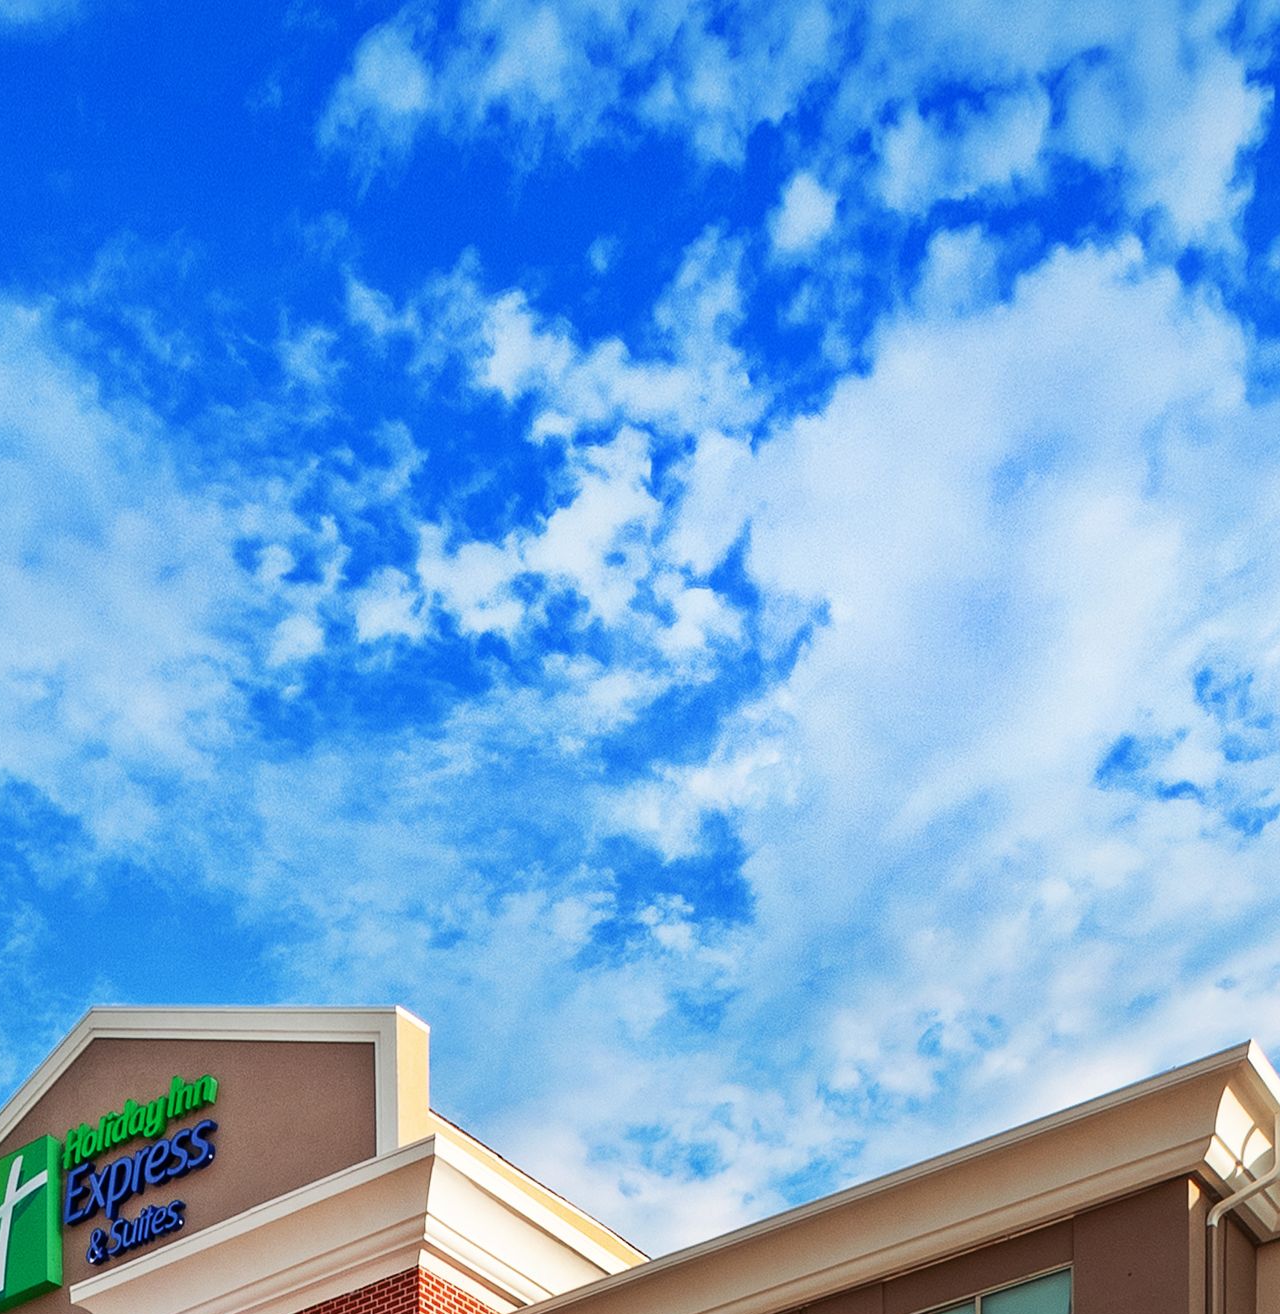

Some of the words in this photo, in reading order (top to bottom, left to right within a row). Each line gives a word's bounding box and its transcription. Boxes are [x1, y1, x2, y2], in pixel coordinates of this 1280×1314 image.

[63, 1099, 167, 1168] Holiday
[166, 1074, 218, 1119] Inn
[63, 1119, 219, 1226] Express
[86, 1228, 108, 1266] &
[106, 1200, 186, 1257] Suites
